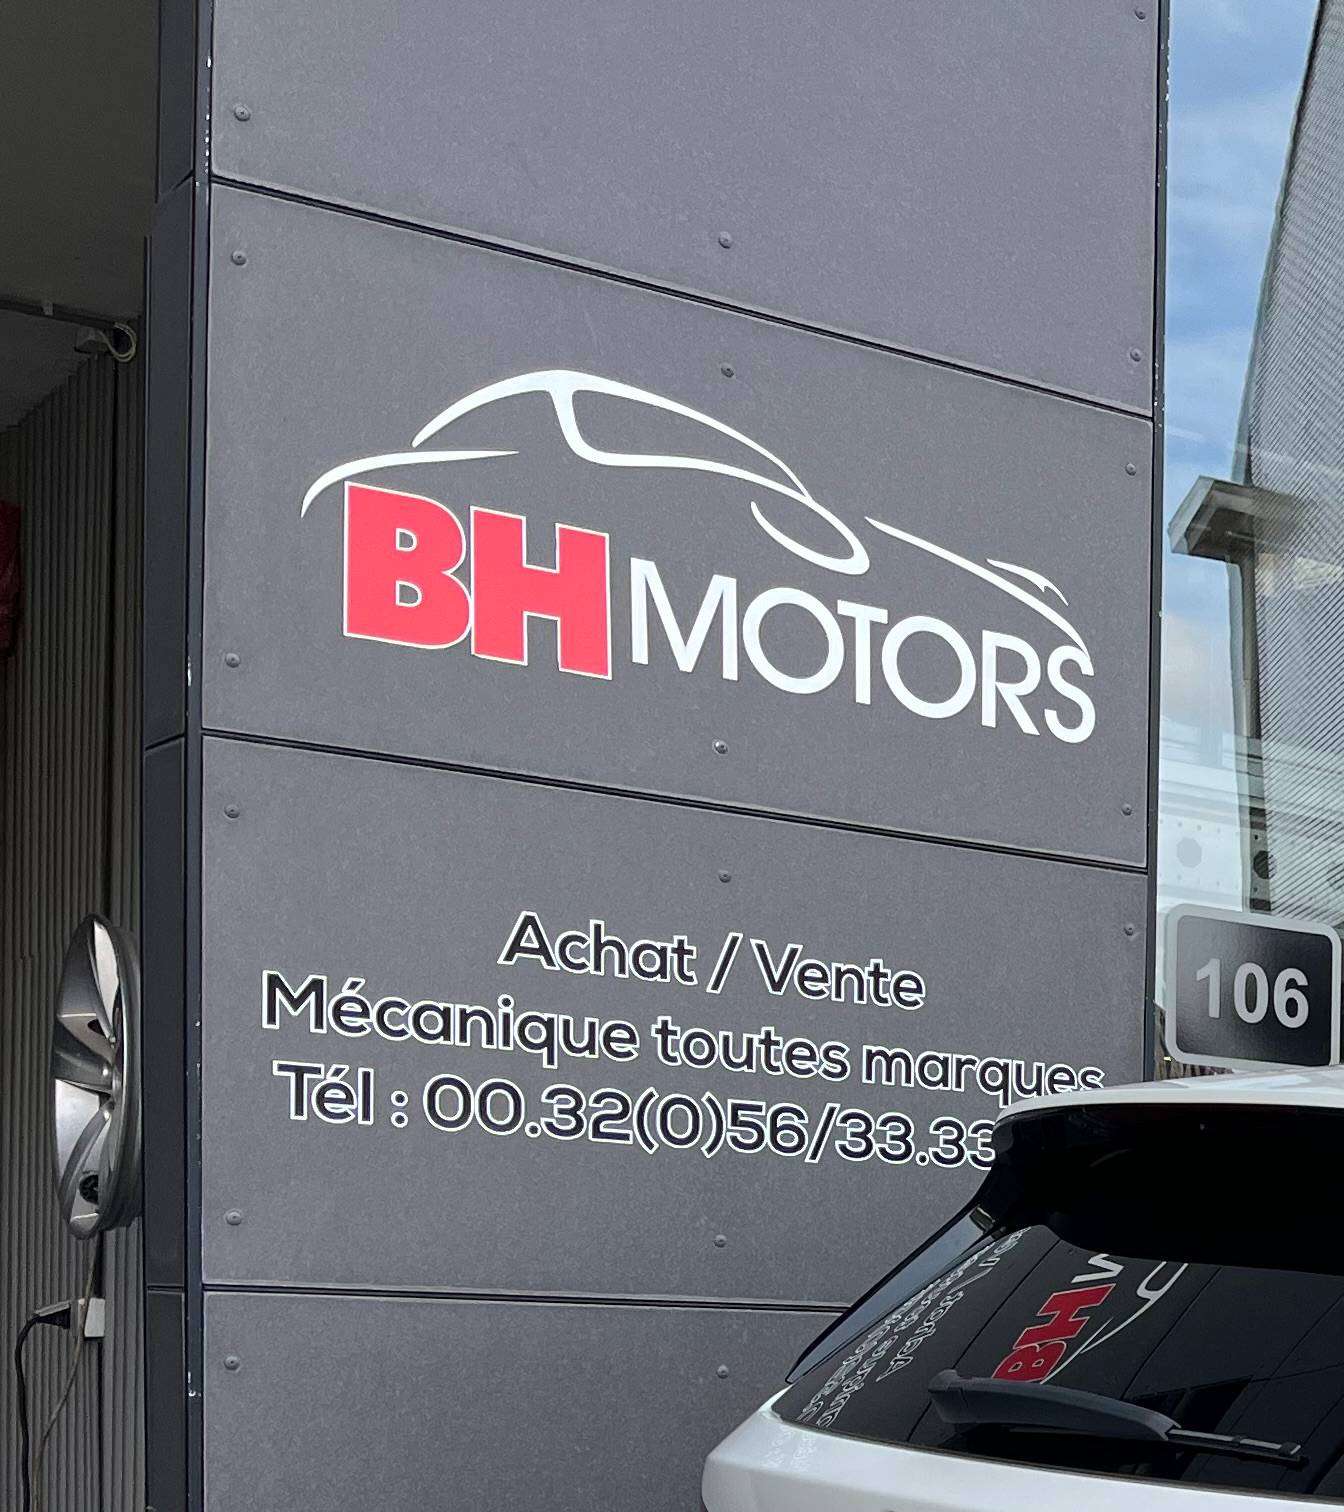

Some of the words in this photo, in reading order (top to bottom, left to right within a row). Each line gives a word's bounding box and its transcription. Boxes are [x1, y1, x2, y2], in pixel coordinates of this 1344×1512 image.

[344, 480, 612, 680] BH
[630, 557, 1095, 744] MOTORS
[498, 909, 697, 987] Achat
[706, 931, 743, 993] /
[750, 938, 926, 1011] Vente
[1195, 958, 1310, 1029] 106
[261, 970, 639, 1069] Mécanique
[650, 1015, 851, 1082] toutes
[862, 1044, 1105, 1109] marques
[272, 1059, 376, 1127] Tél
